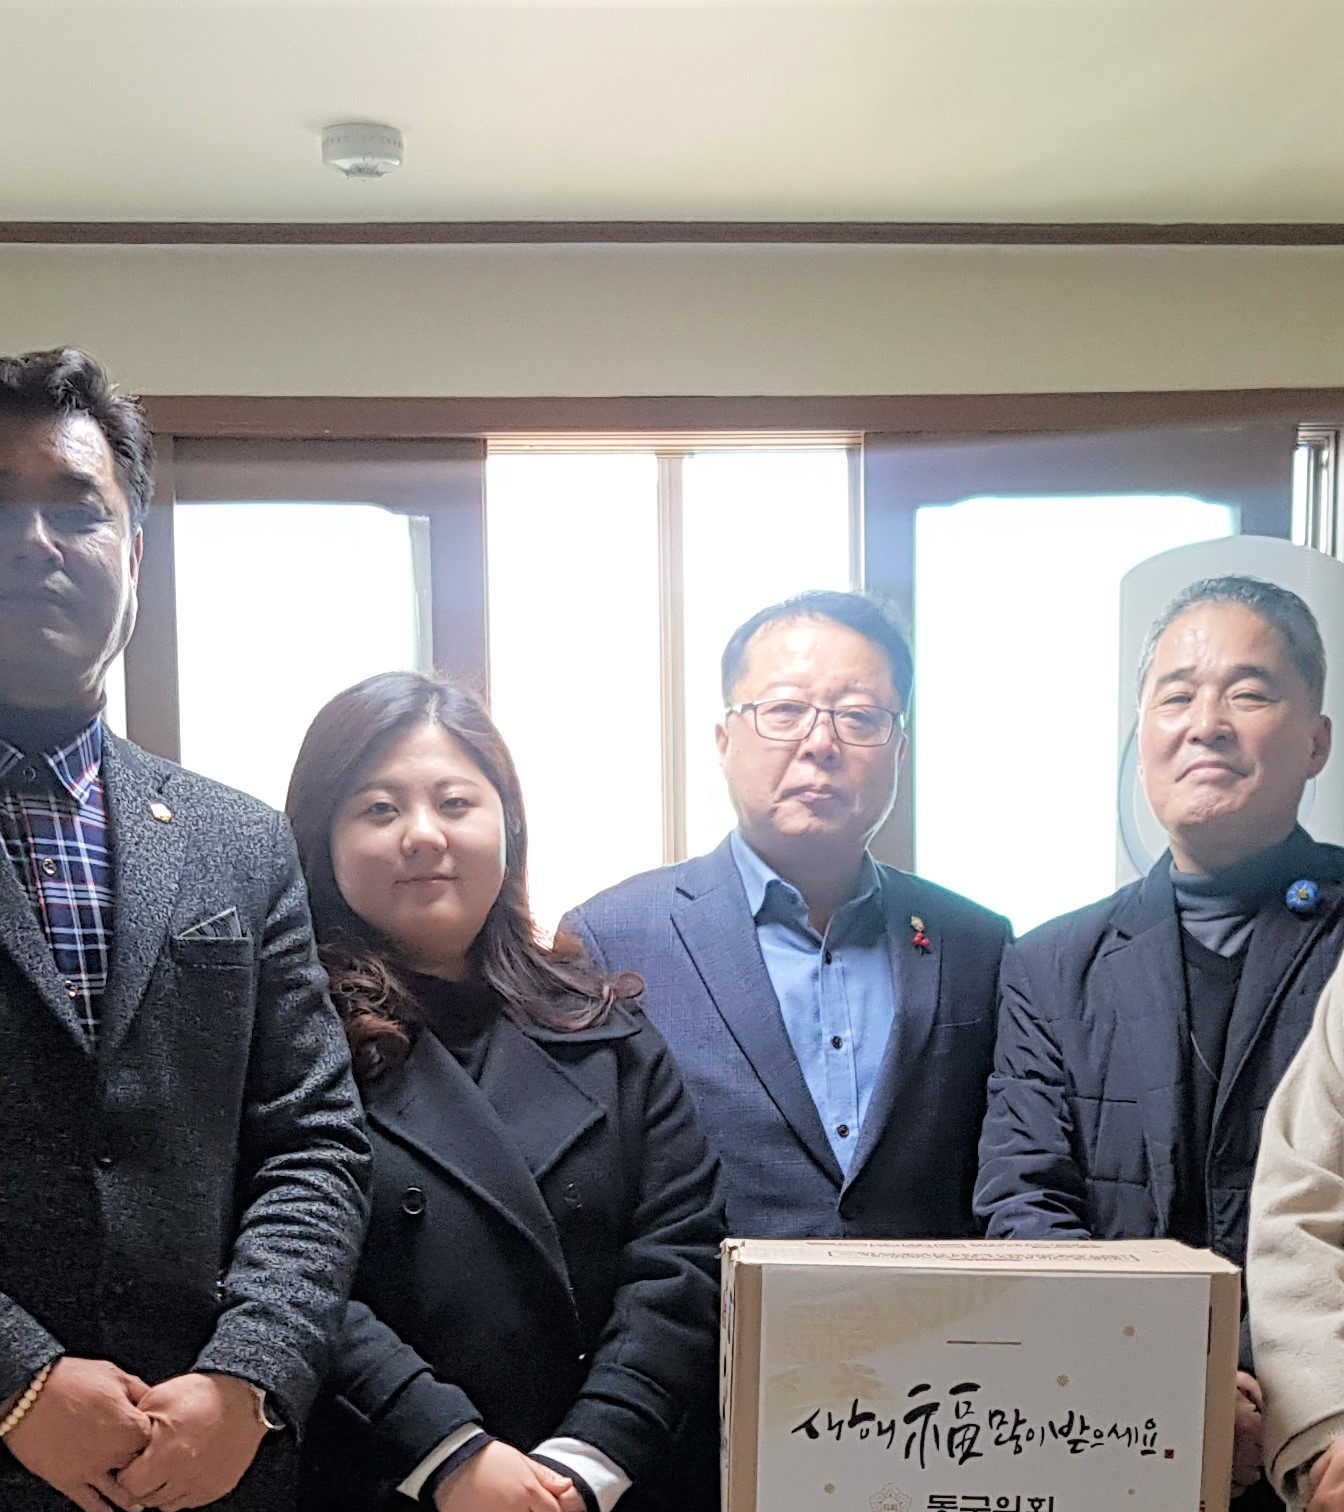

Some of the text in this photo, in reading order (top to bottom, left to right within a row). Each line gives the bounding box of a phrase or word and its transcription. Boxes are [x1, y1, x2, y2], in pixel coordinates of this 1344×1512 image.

[790, 1397, 895, 1450] 새해
[902, 1382, 984, 1469] 福
[987, 1408, 1047, 1455] 많이
